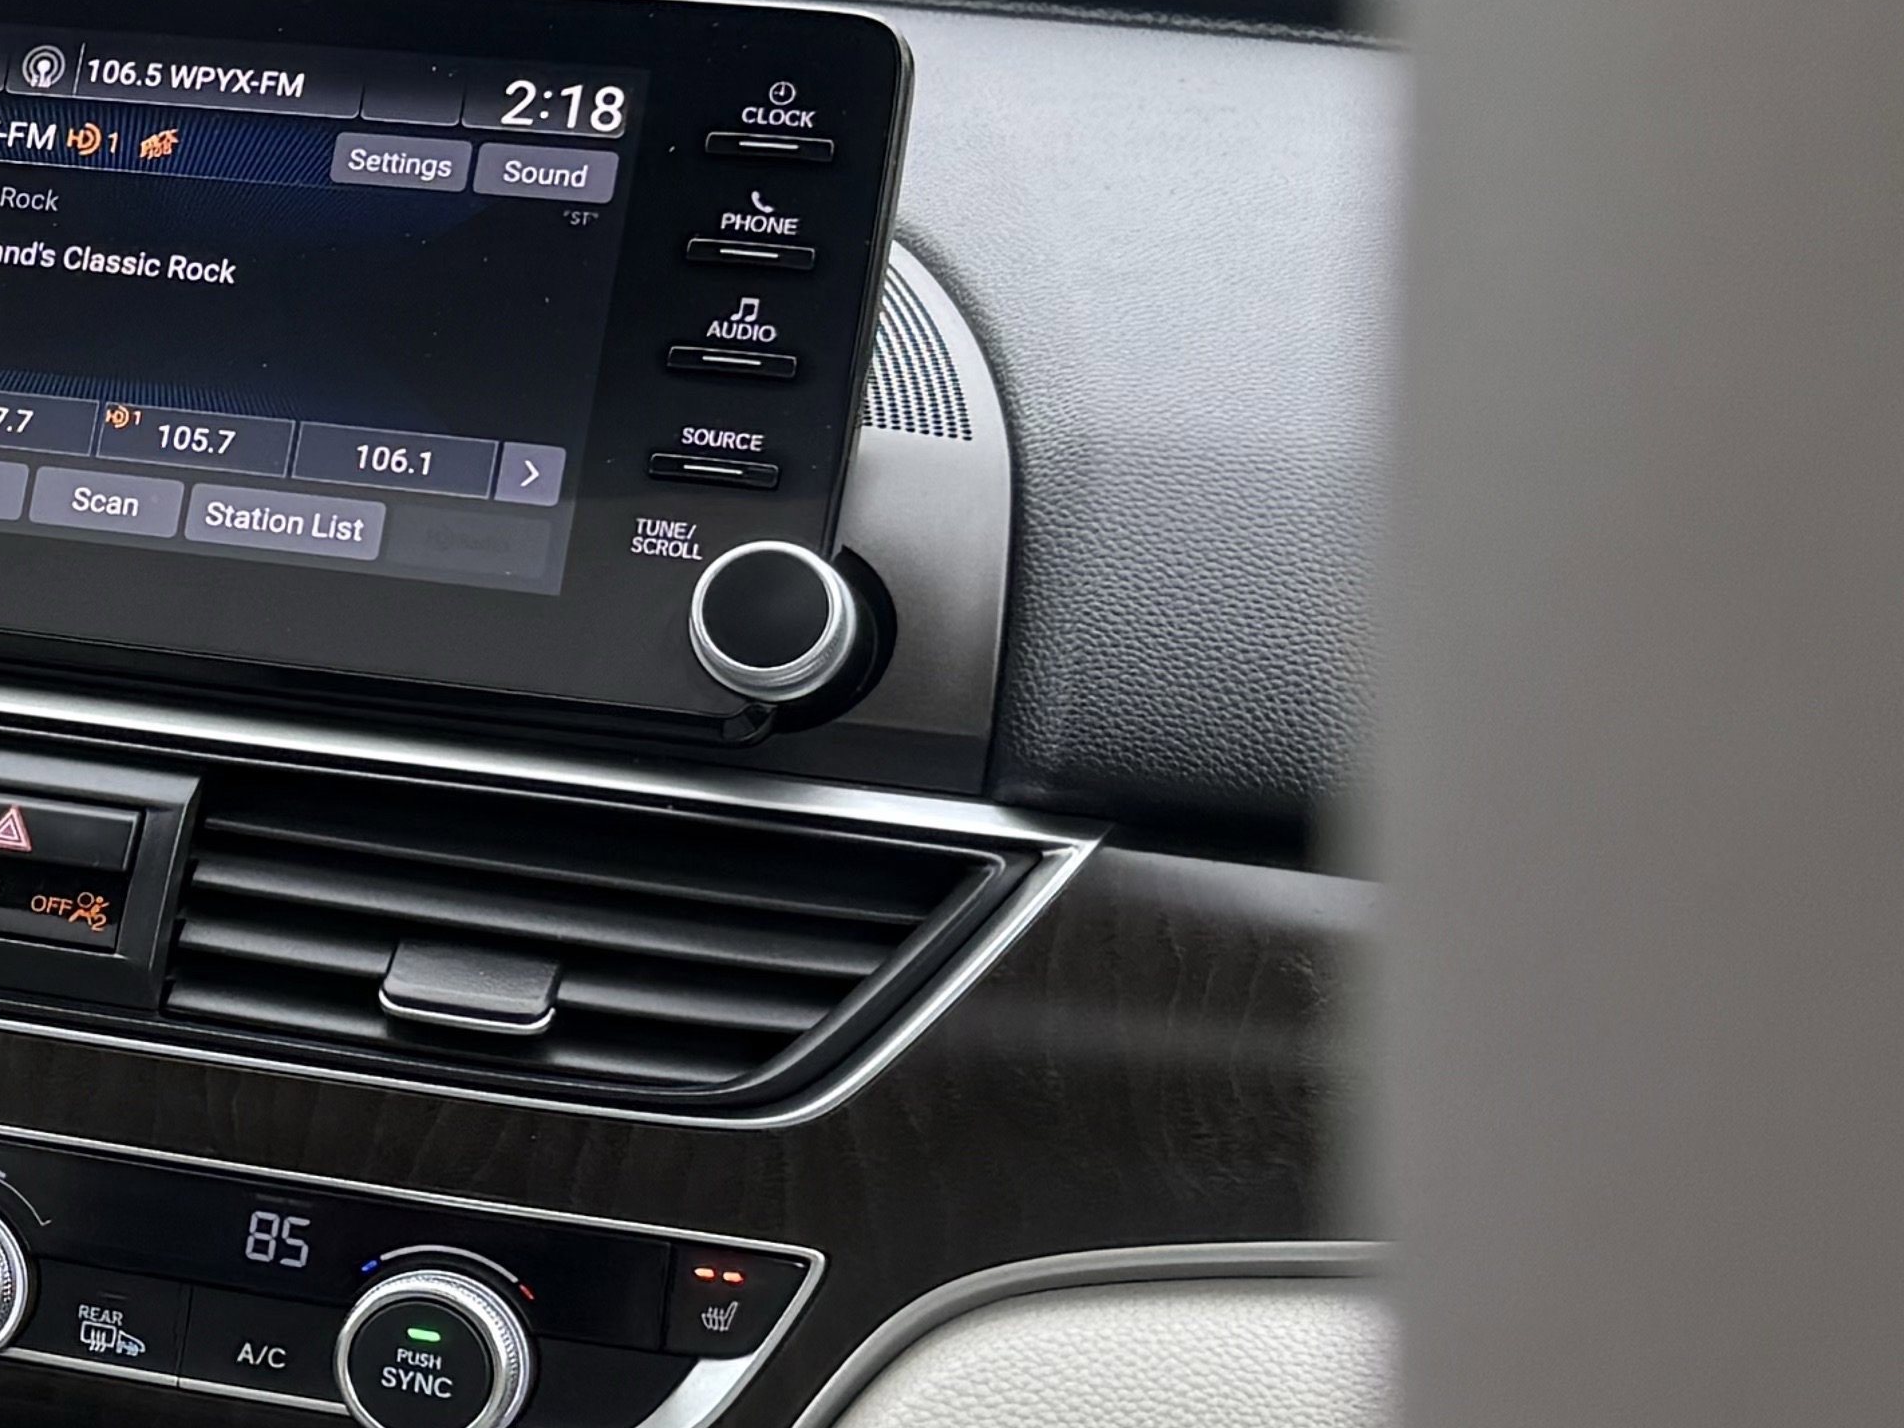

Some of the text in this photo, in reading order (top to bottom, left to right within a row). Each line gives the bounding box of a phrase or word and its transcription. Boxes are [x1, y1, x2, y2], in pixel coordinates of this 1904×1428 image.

[87, 58, 305, 100] 106.5 WPYX-FM
[500, 79, 625, 133] 2:18
[741, 105, 815, 129] CLOCK
[348, 148, 453, 184] Settings
[503, 159, 588, 190] Sound
[1, 185, 59, 213] Rock
[720, 212, 798, 237] PHONE
[63, 245, 159, 279] Classic
[167, 254, 236, 286] Rock
[706, 321, 777, 344] AUDIO
[157, 423, 235, 456] 105.7
[681, 426, 764, 453] SOURCE
[354, 443, 433, 477] 106.1
[71, 486, 140, 519] Scan
[204, 501, 364, 543] Station List
[634, 517, 697, 543] TUNE/
[630, 536, 703, 561] SCROLL
[30, 894, 73, 916] OFF
[244, 1209, 312, 1270] 85
[78, 1304, 124, 1326] REAR
[236, 1342, 287, 1370] A/C
[395, 1346, 443, 1371] PUSH
[381, 1367, 453, 1400] SYNC
